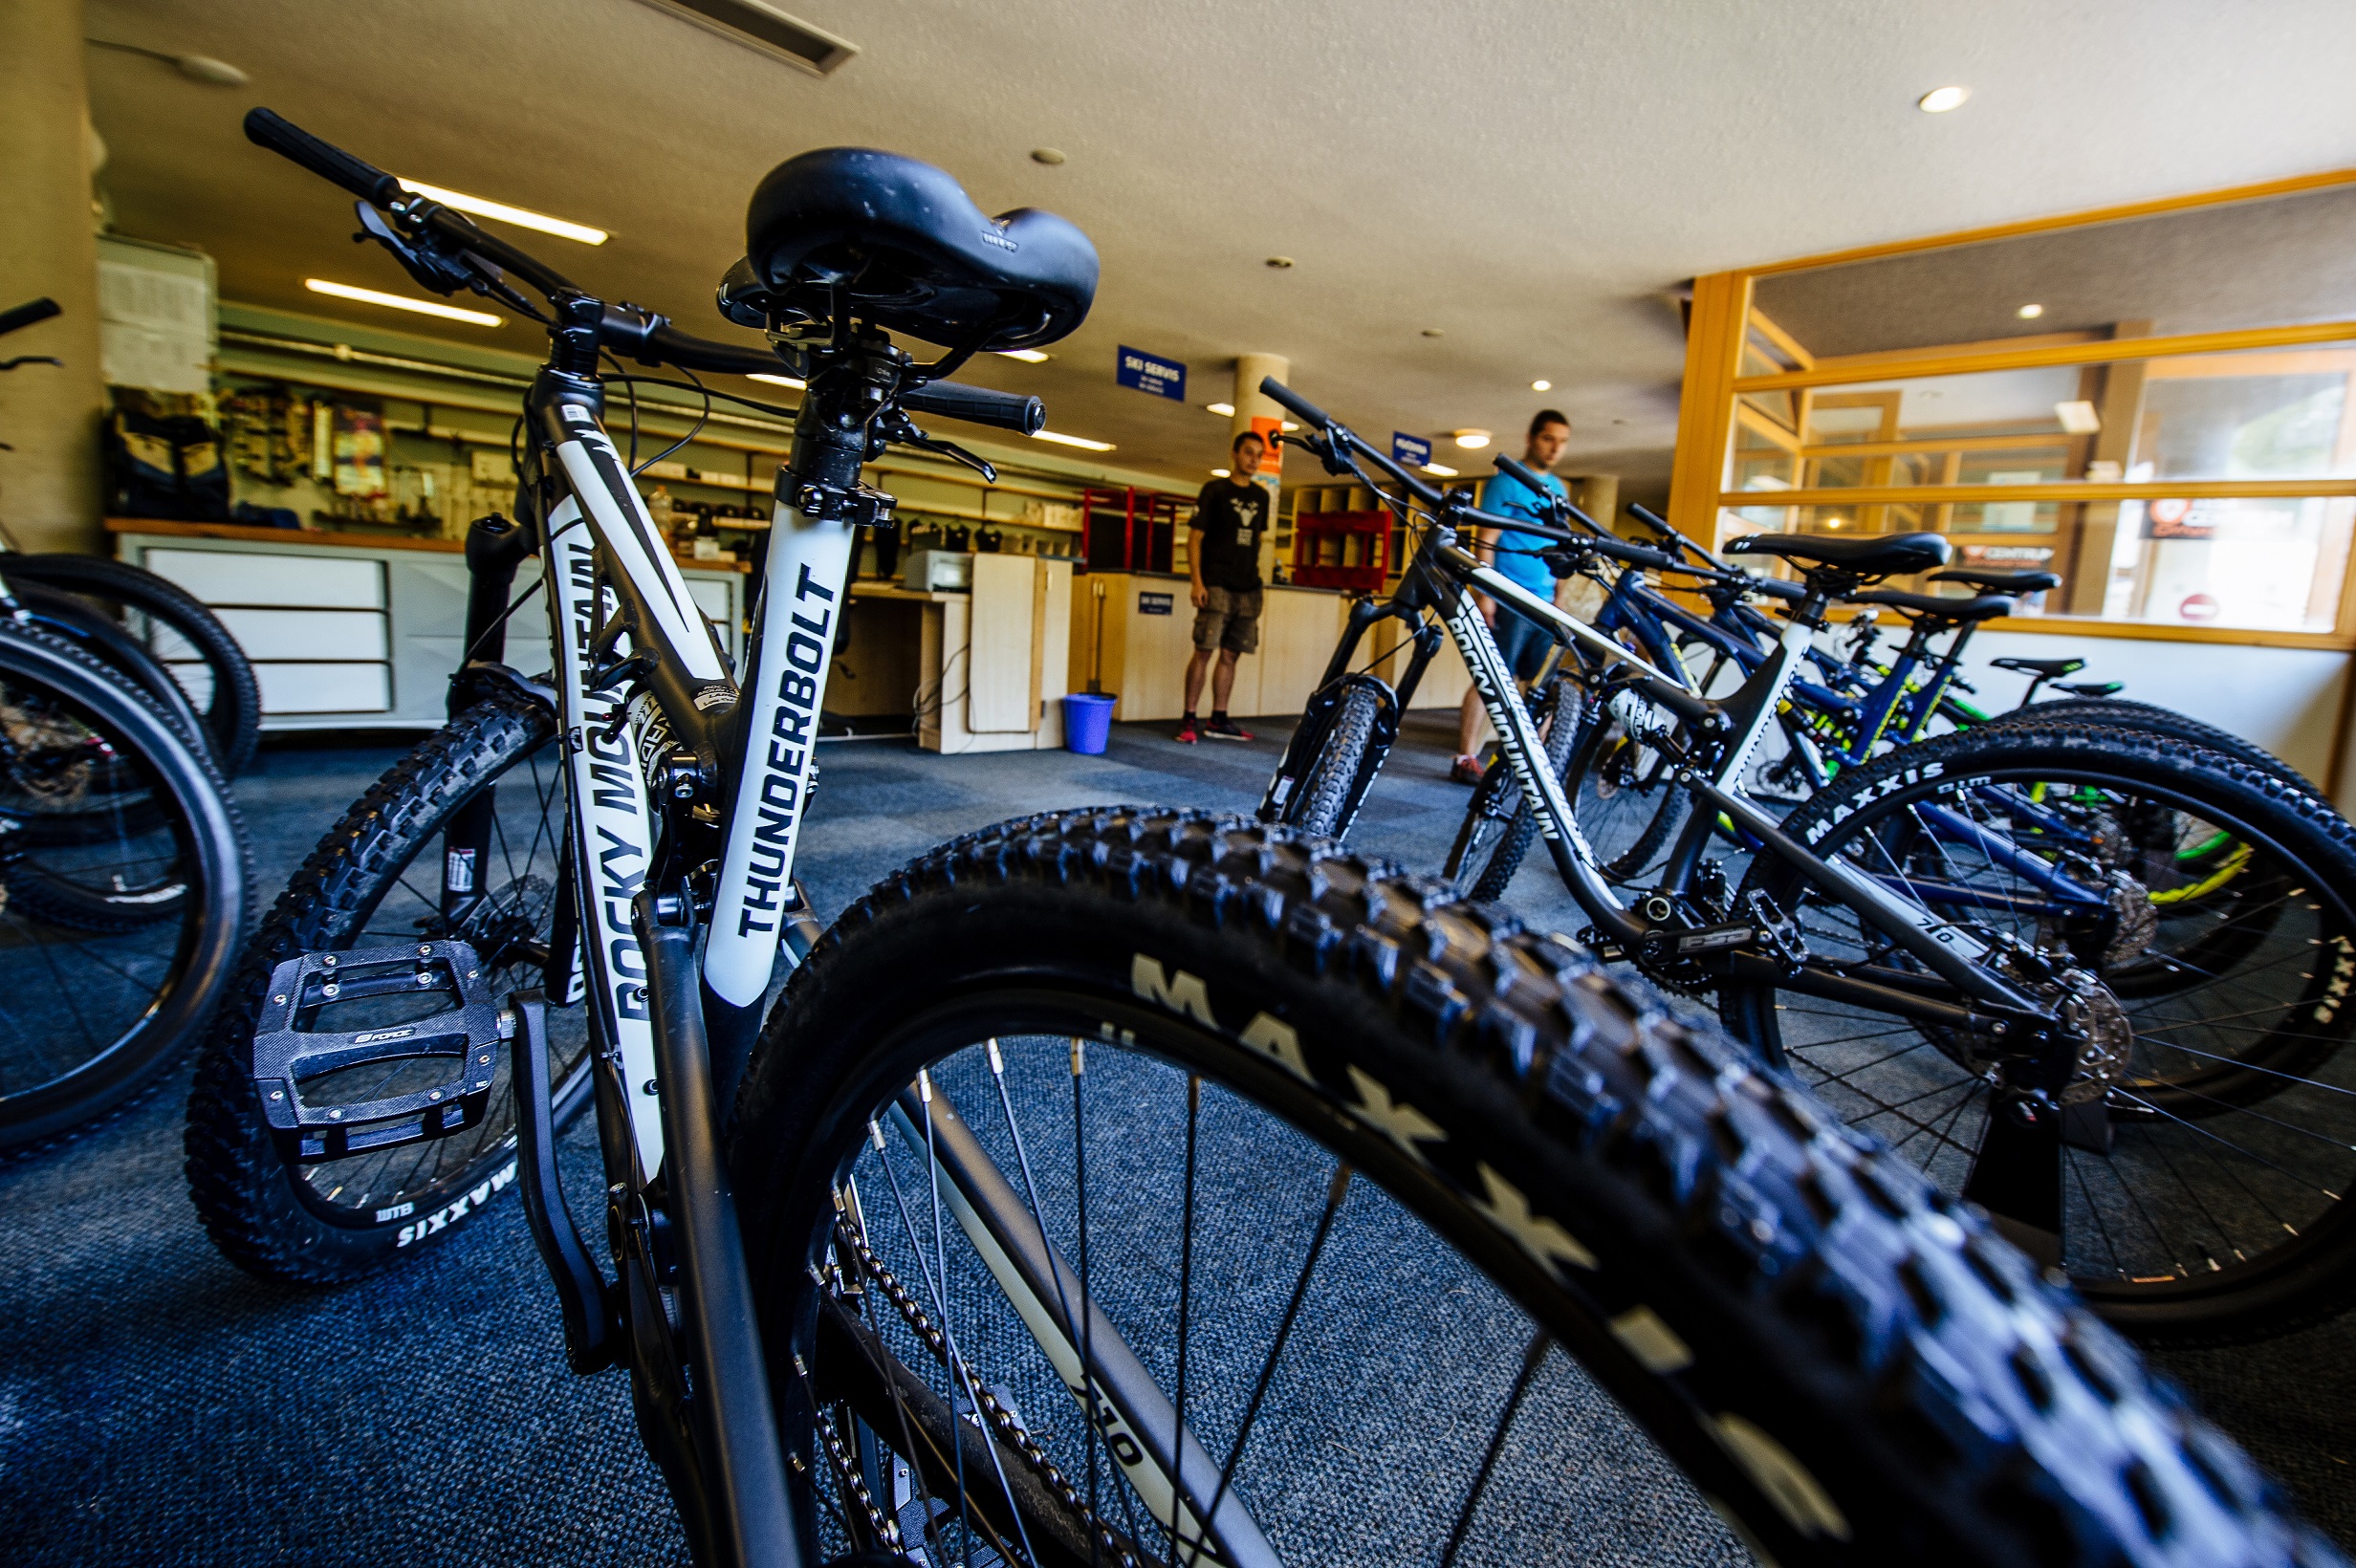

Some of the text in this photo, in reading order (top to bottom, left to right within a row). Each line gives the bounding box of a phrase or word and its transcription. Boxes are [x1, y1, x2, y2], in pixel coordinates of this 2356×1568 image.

[1125, 356, 1180, 382] SKI SERVIS
[739, 563, 834, 938] THUNDERBOLT
[1447, 617, 1560, 839] ROCKY MOUNTAIN
[1805, 762, 1944, 845] MAXXIS
[375, 1201, 416, 1223] WTB
[397, 1160, 517, 1248] MAXXIS
[1132, 953, 1849, 1541] MAXXIS
